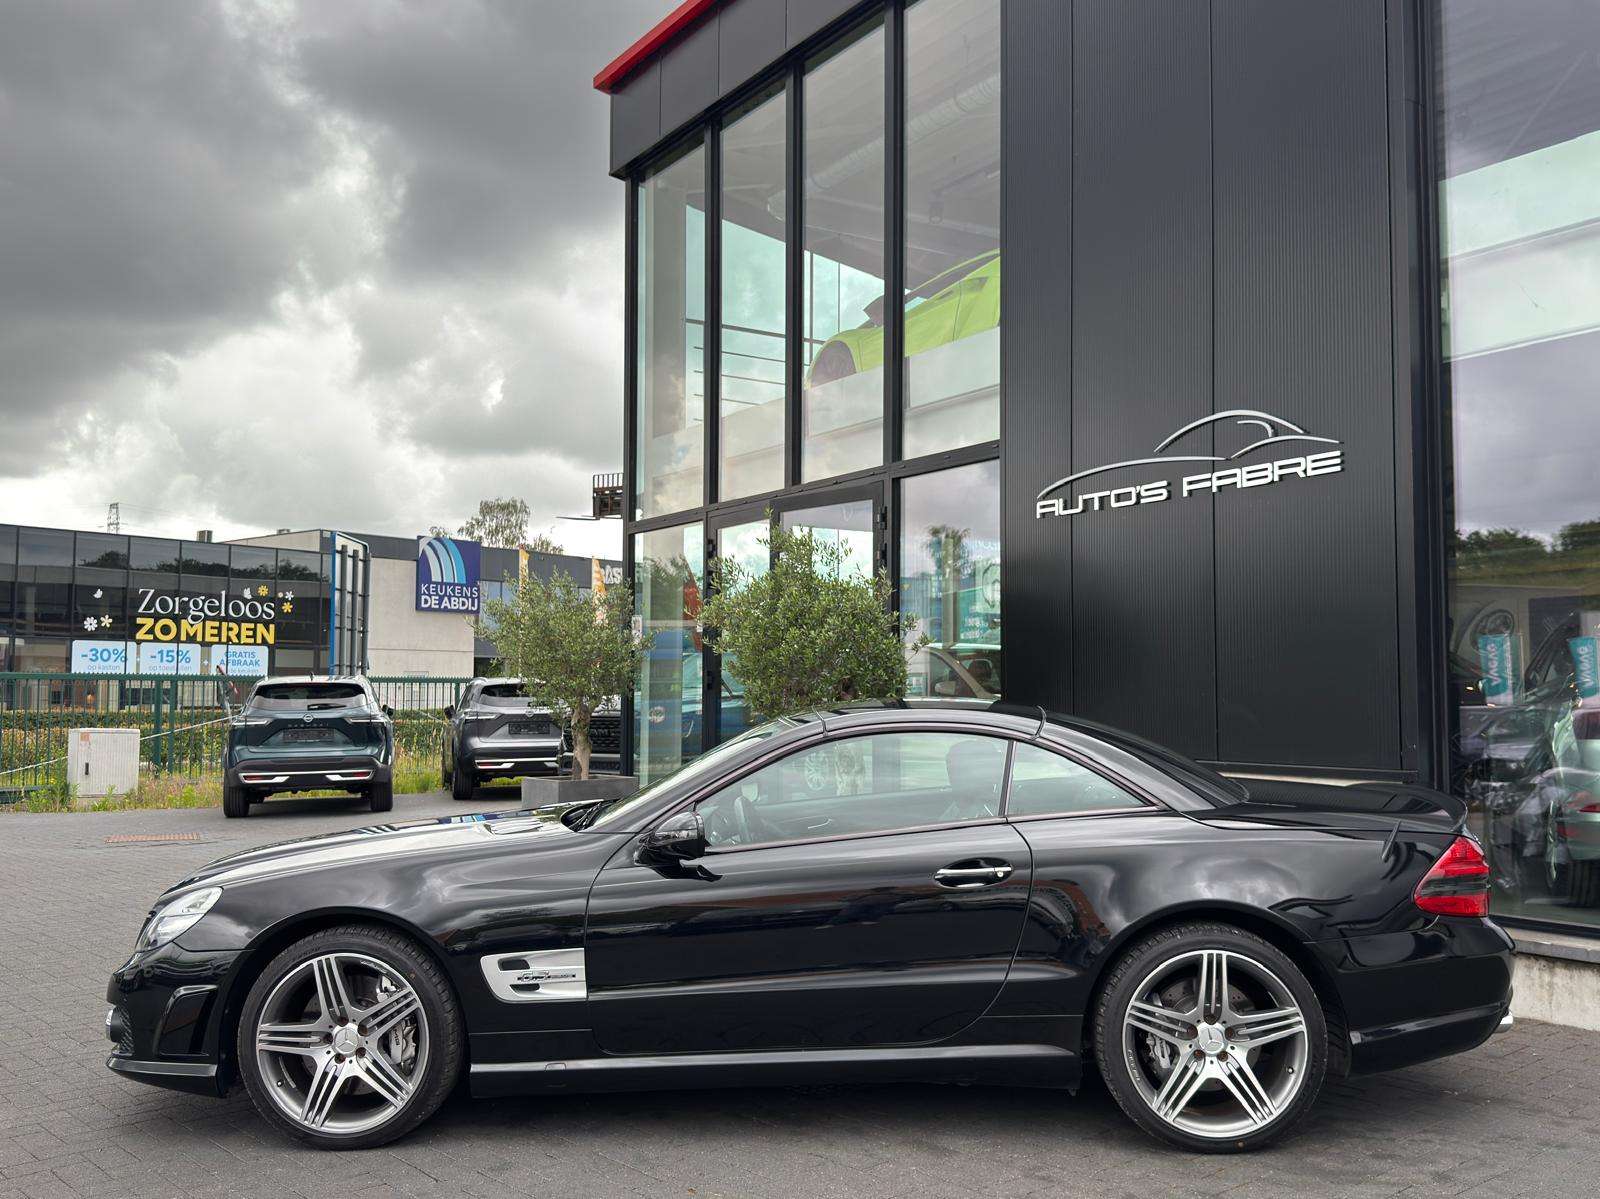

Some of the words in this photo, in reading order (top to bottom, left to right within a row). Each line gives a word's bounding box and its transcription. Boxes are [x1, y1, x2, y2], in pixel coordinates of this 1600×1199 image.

[1036, 480, 1168, 519] AUTO'S
[1182, 450, 1342, 497] FABRE
[421, 583, 478, 598] KEUKENS
[137, 588, 275, 624] Zorgeloos
[421, 595, 439, 608] DE
[440, 596, 479, 611] ABDIJ
[135, 617, 276, 645] ZOMEREN
[81, 647, 128, 663] -30%
[150, 649, 191, 664] -15%
[219, 658, 260, 667] AFBRAAK
[224, 651, 256, 659] GRATIS
